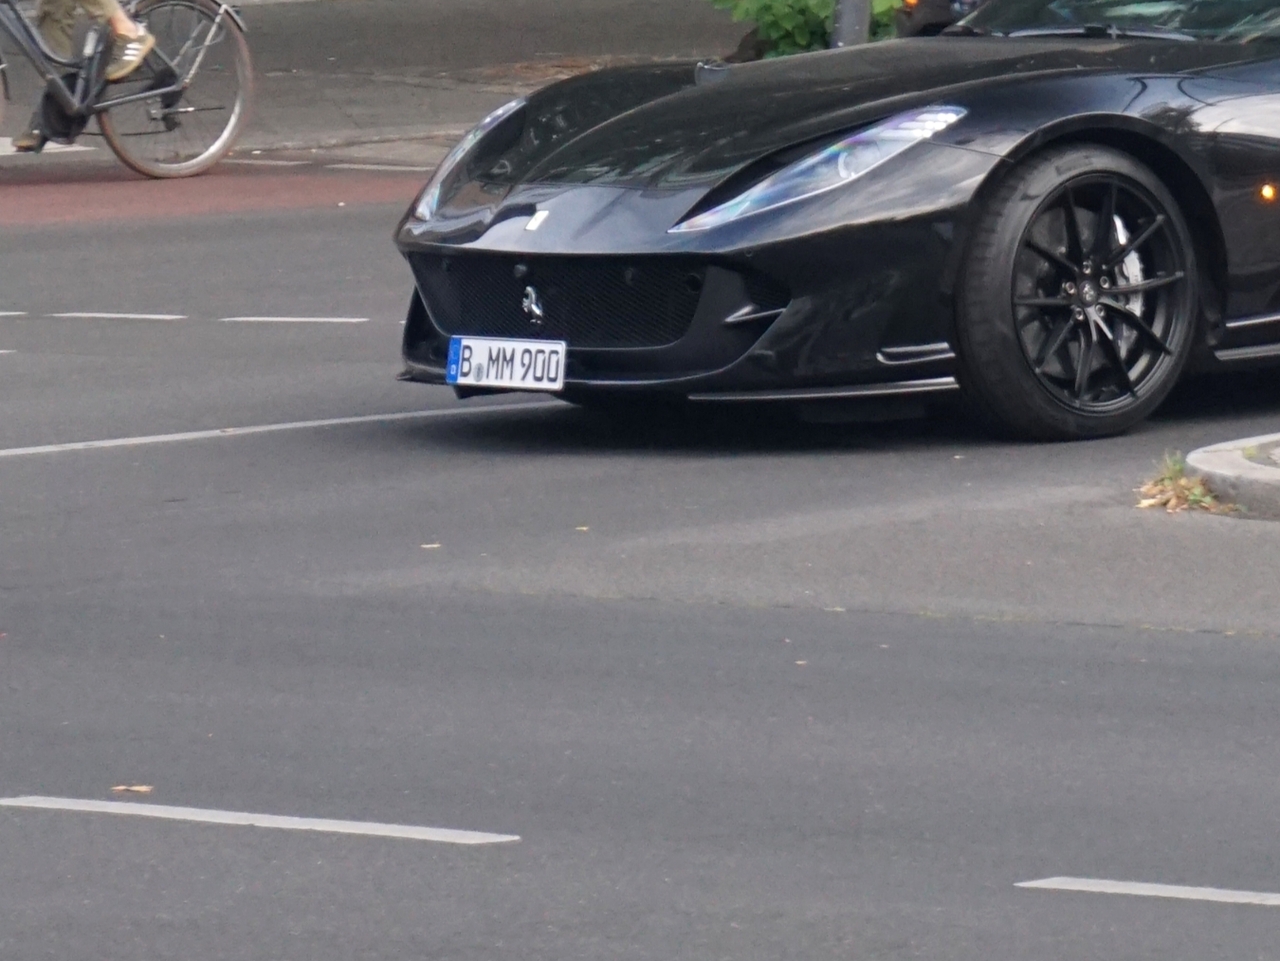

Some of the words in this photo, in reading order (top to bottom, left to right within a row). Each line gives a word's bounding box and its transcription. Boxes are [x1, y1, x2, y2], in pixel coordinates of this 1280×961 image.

[459, 344, 473, 378] B
[485, 345, 516, 381] MM
[520, 347, 560, 383] 900
